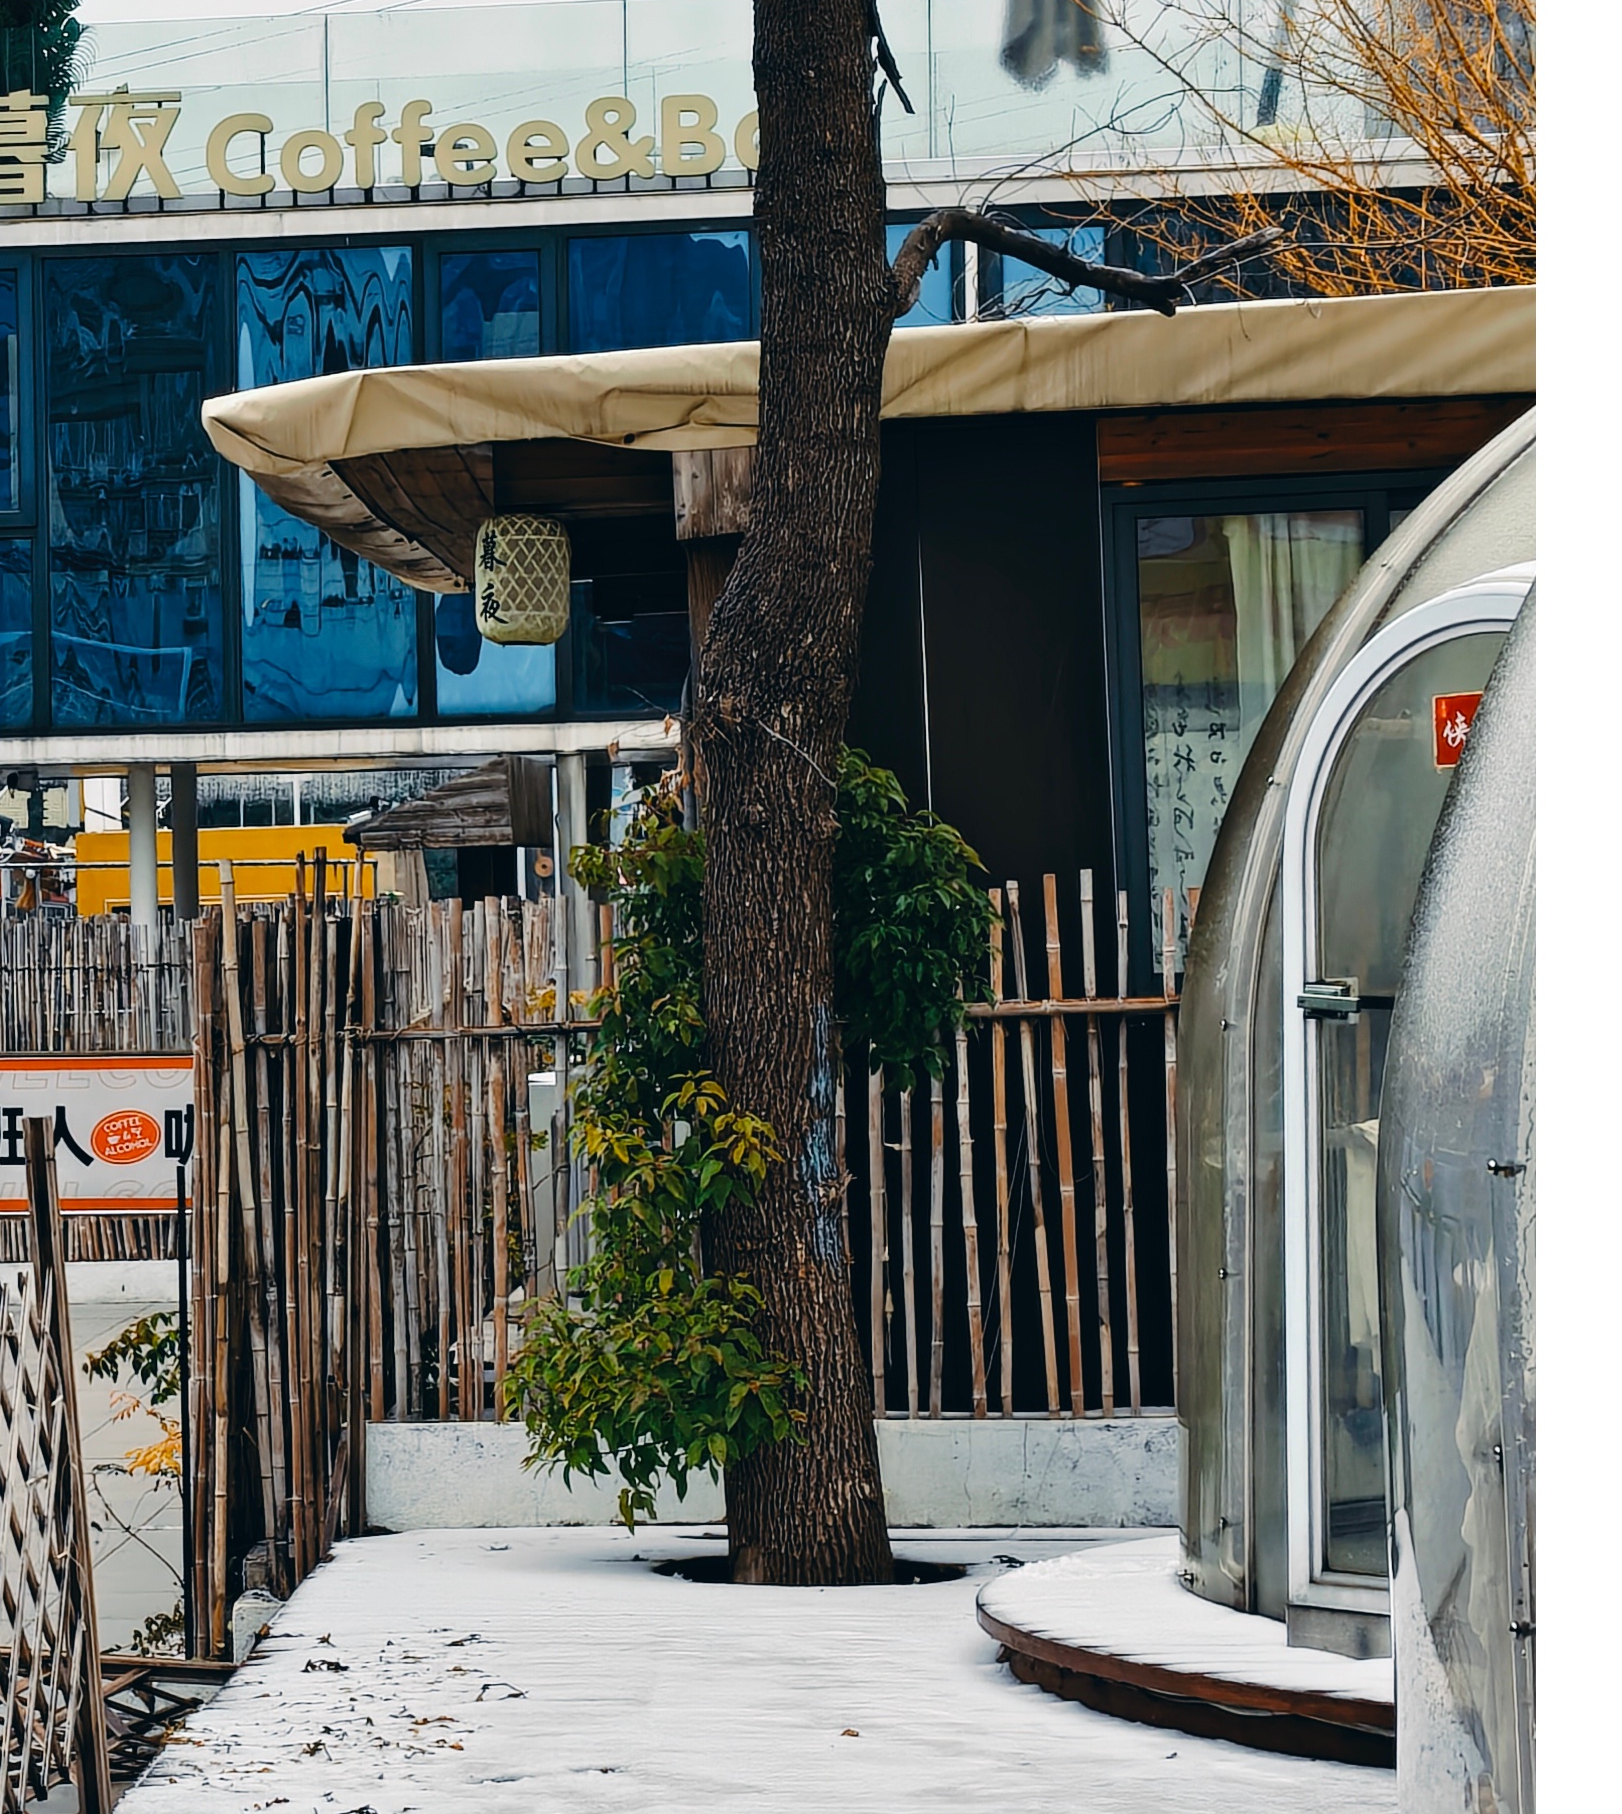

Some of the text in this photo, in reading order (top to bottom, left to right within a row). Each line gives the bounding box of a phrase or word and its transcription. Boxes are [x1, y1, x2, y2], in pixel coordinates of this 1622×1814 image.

[479, 529, 509, 624] 暮夜
[103, 1117, 142, 1133] COFFEE
[105, 1138, 153, 1156] ALCOHOL
